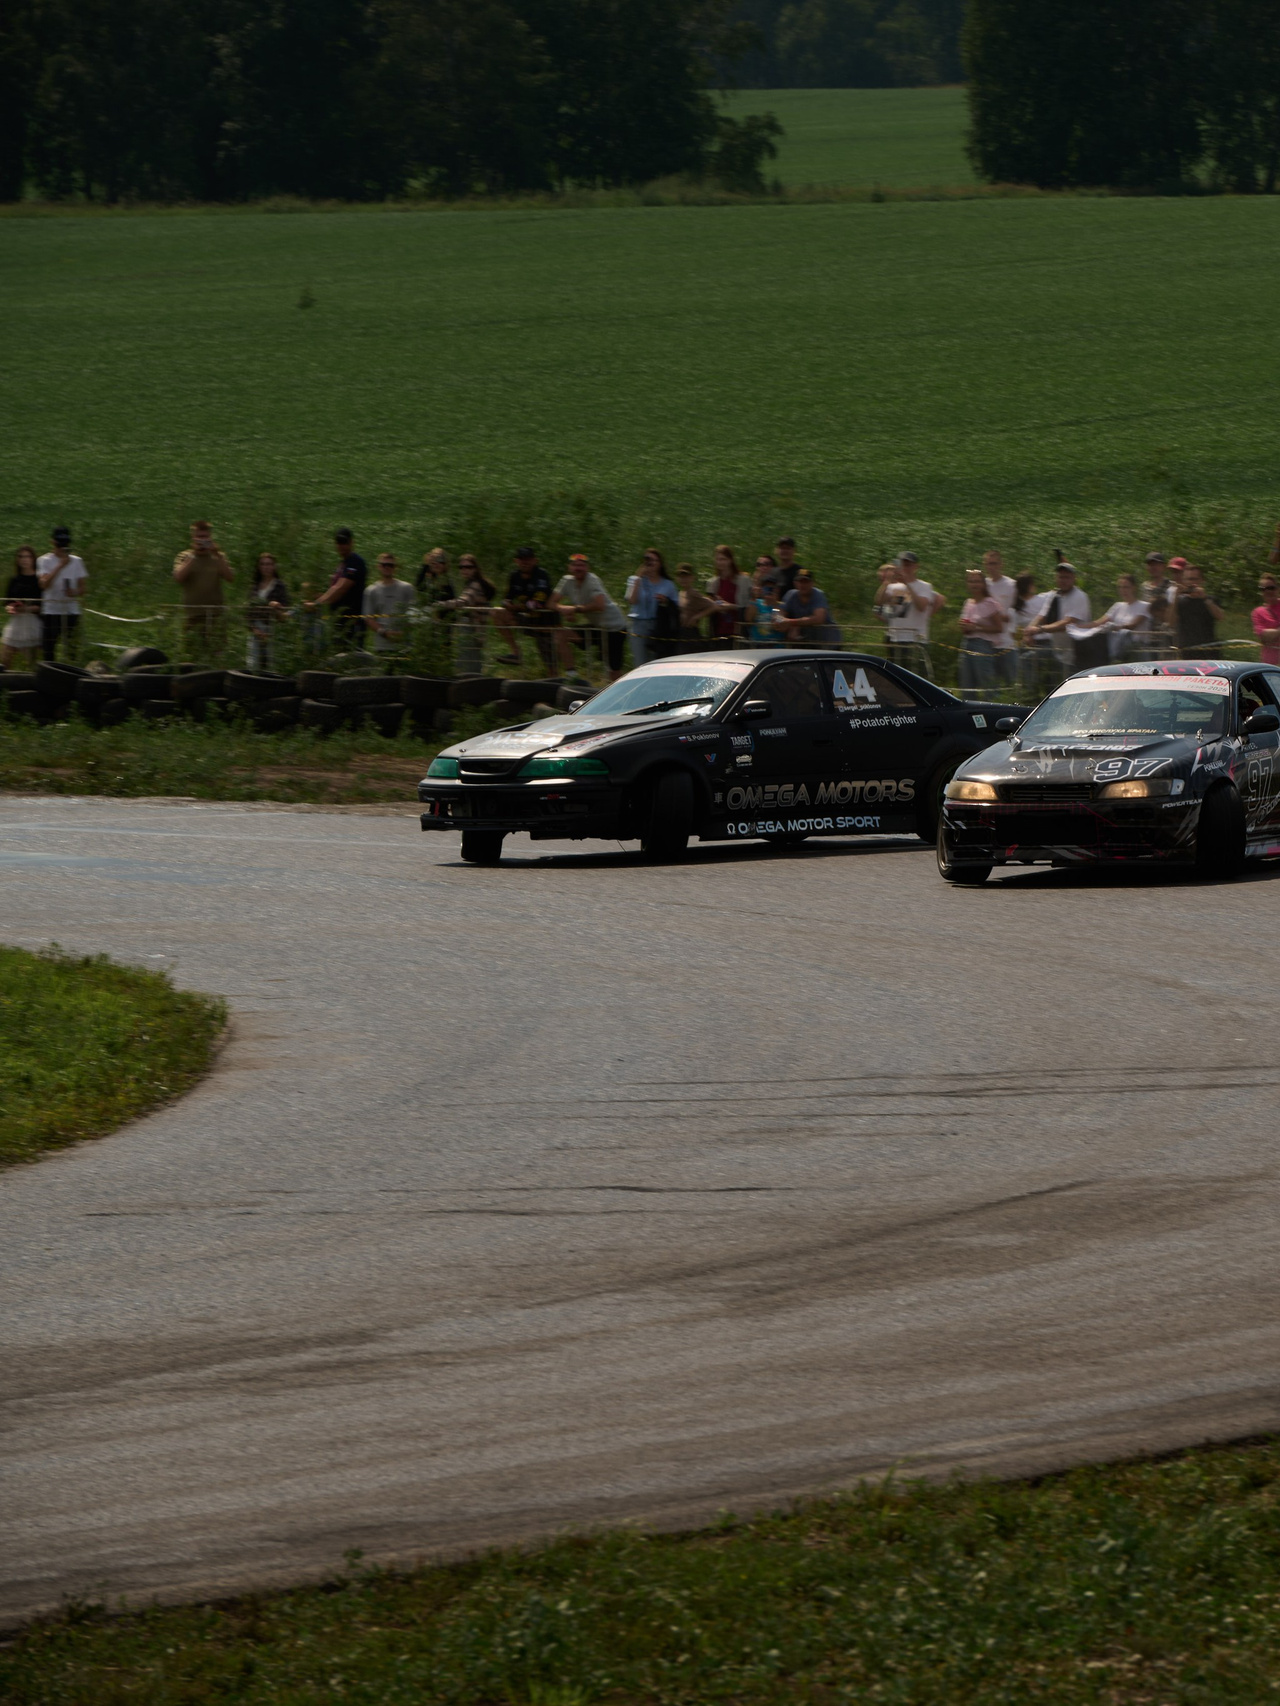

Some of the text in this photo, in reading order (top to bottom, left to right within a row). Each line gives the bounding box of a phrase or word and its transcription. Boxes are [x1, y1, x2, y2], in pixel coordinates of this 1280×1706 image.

[832, 668, 877, 704] 44
[1182, 676, 1230, 688] РАКЕТЫ
[849, 715, 918, 730] #PotatoFighter
[730, 735, 752, 746] TARGET
[1093, 757, 1174, 783] 97
[727, 778, 916, 810] OMEGA MOTORS
[1248, 756, 1273, 811] 97
[787, 816, 835, 832] MOTOR
[835, 815, 882, 829] SPORT
